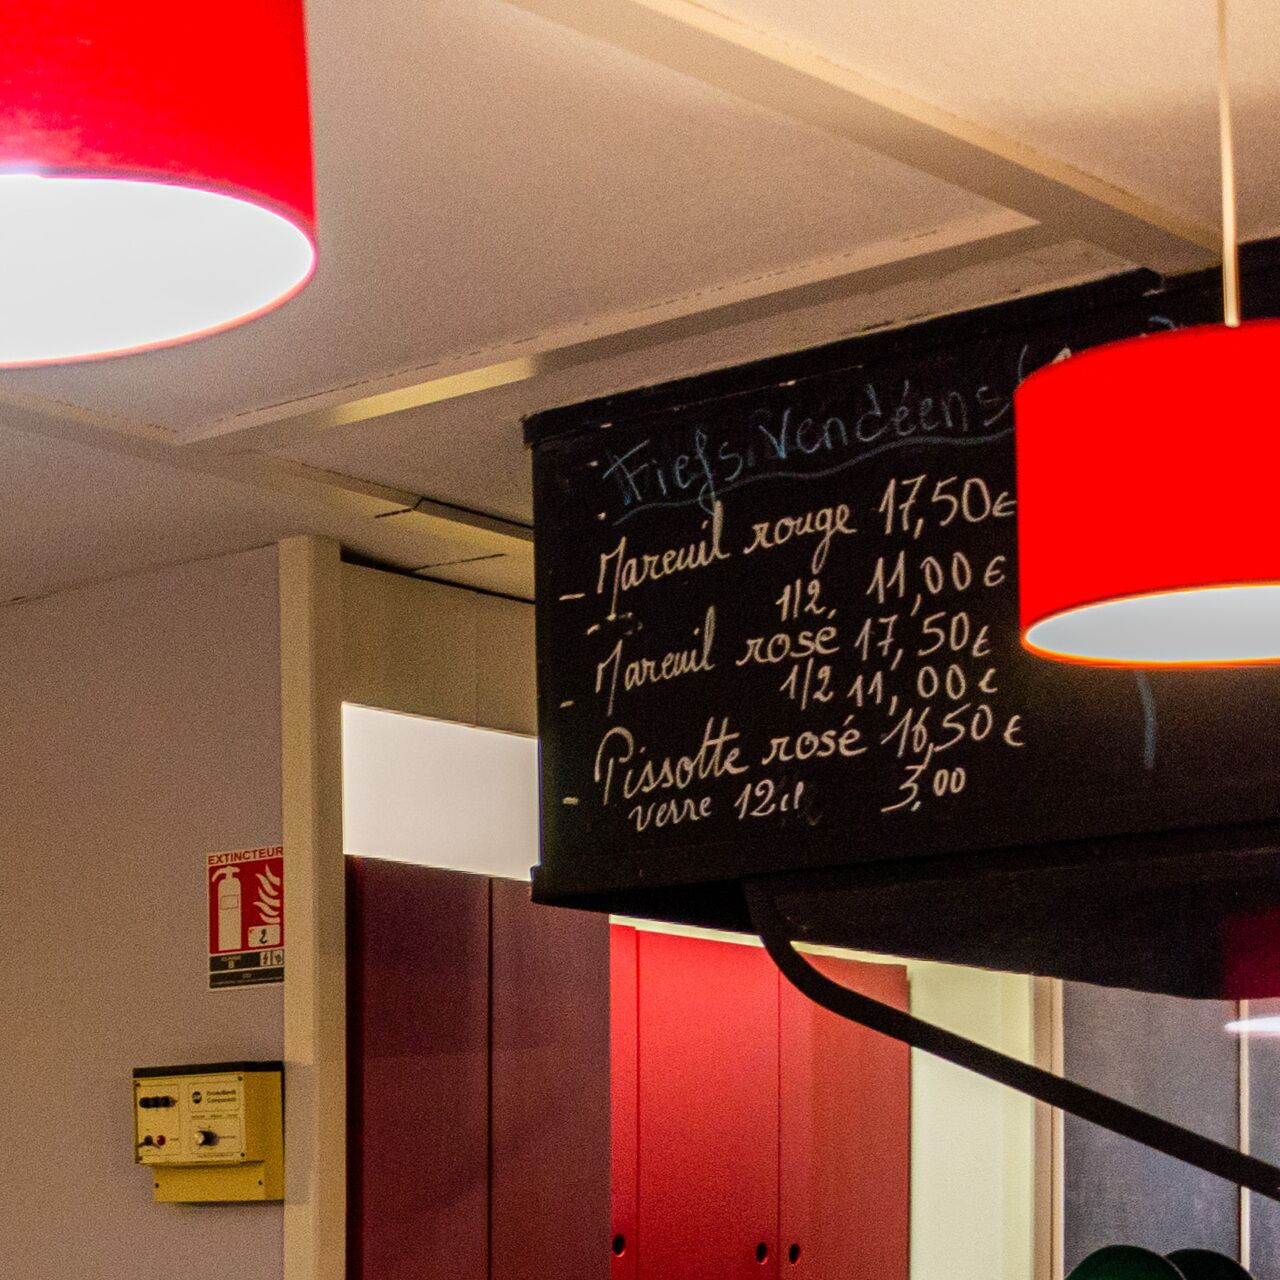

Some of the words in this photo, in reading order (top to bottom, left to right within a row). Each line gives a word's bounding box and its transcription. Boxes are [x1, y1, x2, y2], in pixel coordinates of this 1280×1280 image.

[596, 500, 731, 620] Mareuil
[743, 503, 857, 576] rouge
[594, 605, 716, 717] Mareuil
[780, 657, 834, 711] 1/2
[594, 717, 749, 806] Pissotte
[762, 714, 867, 766] rosé
[628, 796, 713, 832] verre
[207, 846, 284, 866] EXTINCTEUR
